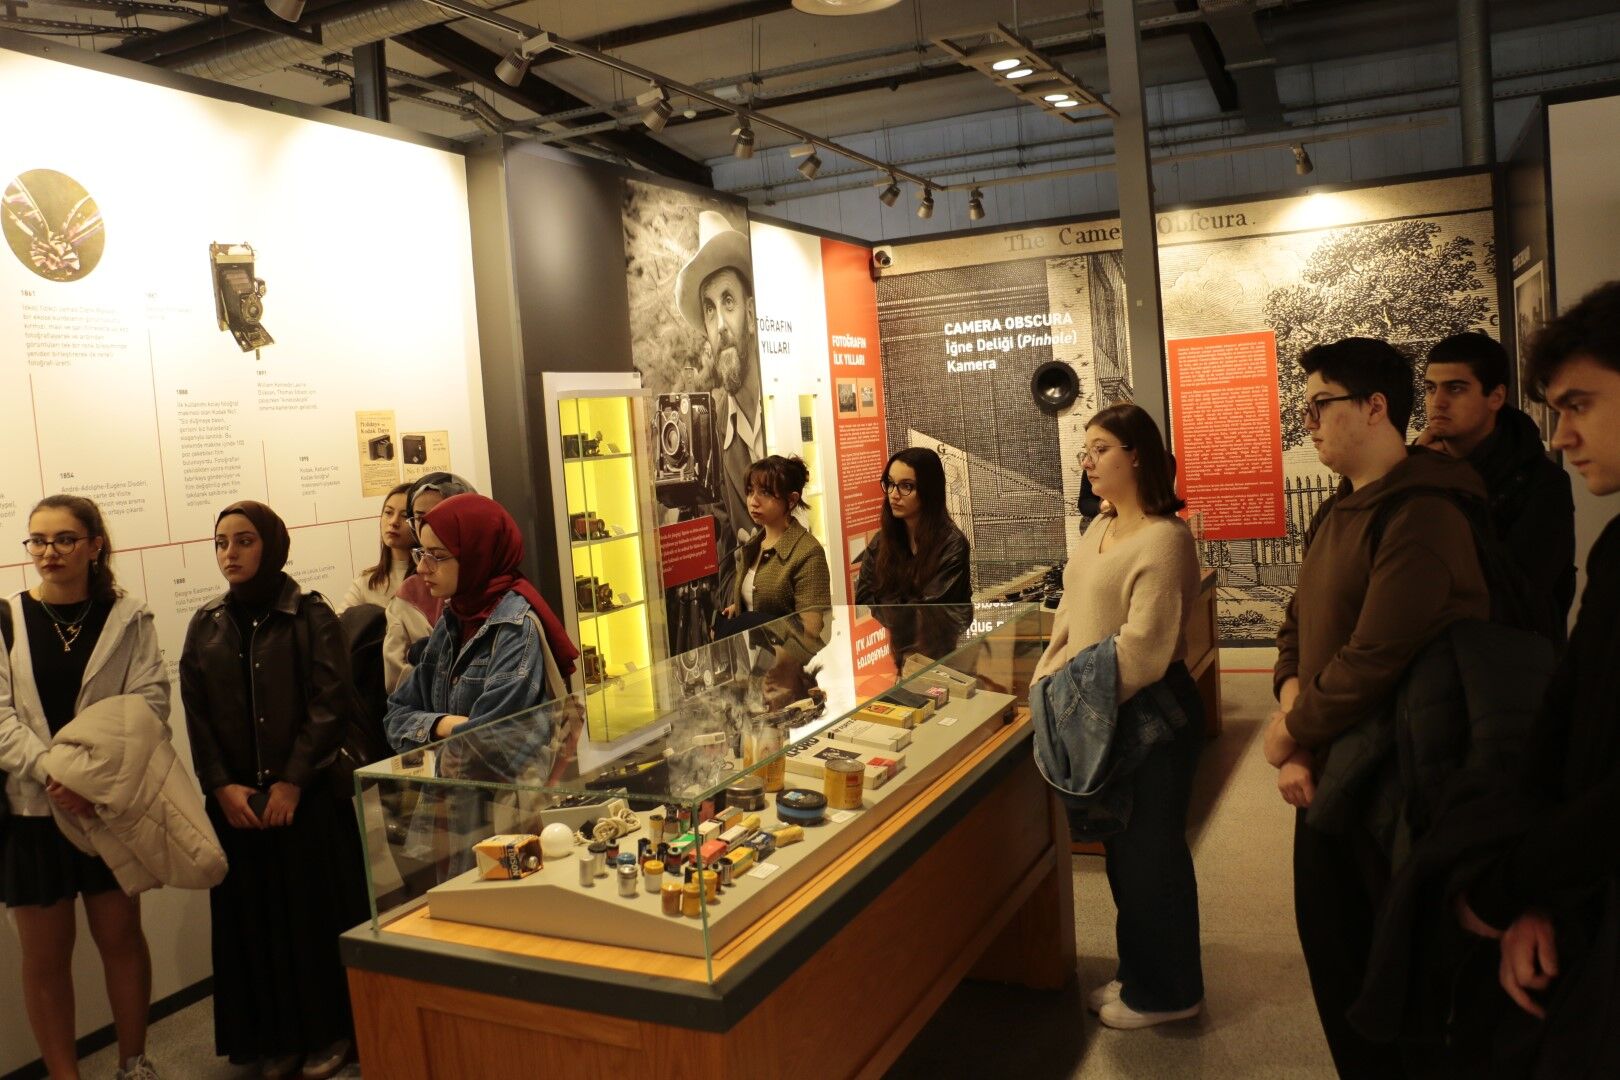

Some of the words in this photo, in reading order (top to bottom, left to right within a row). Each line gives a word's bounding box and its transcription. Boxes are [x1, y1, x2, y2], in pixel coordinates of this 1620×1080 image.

[1004, 232, 1046, 253] The
[1058, 223, 1121, 247] Came
[757, 315, 793, 333] OĞRAFIN
[944, 318, 1002, 336] CAMERA
[1005, 311, 1074, 331] OBSCURA
[761, 340, 790, 354] YILLARI
[832, 333, 867, 349] FOTOĞRAFIN
[945, 338, 973, 357] İğne
[976, 335, 1014, 353] Deliği
[1017, 330, 1078, 349] (Pinhole)
[833, 351, 844, 366] İLK
[845, 353, 865, 366] YILLARI
[946, 359, 997, 373] Kamera
